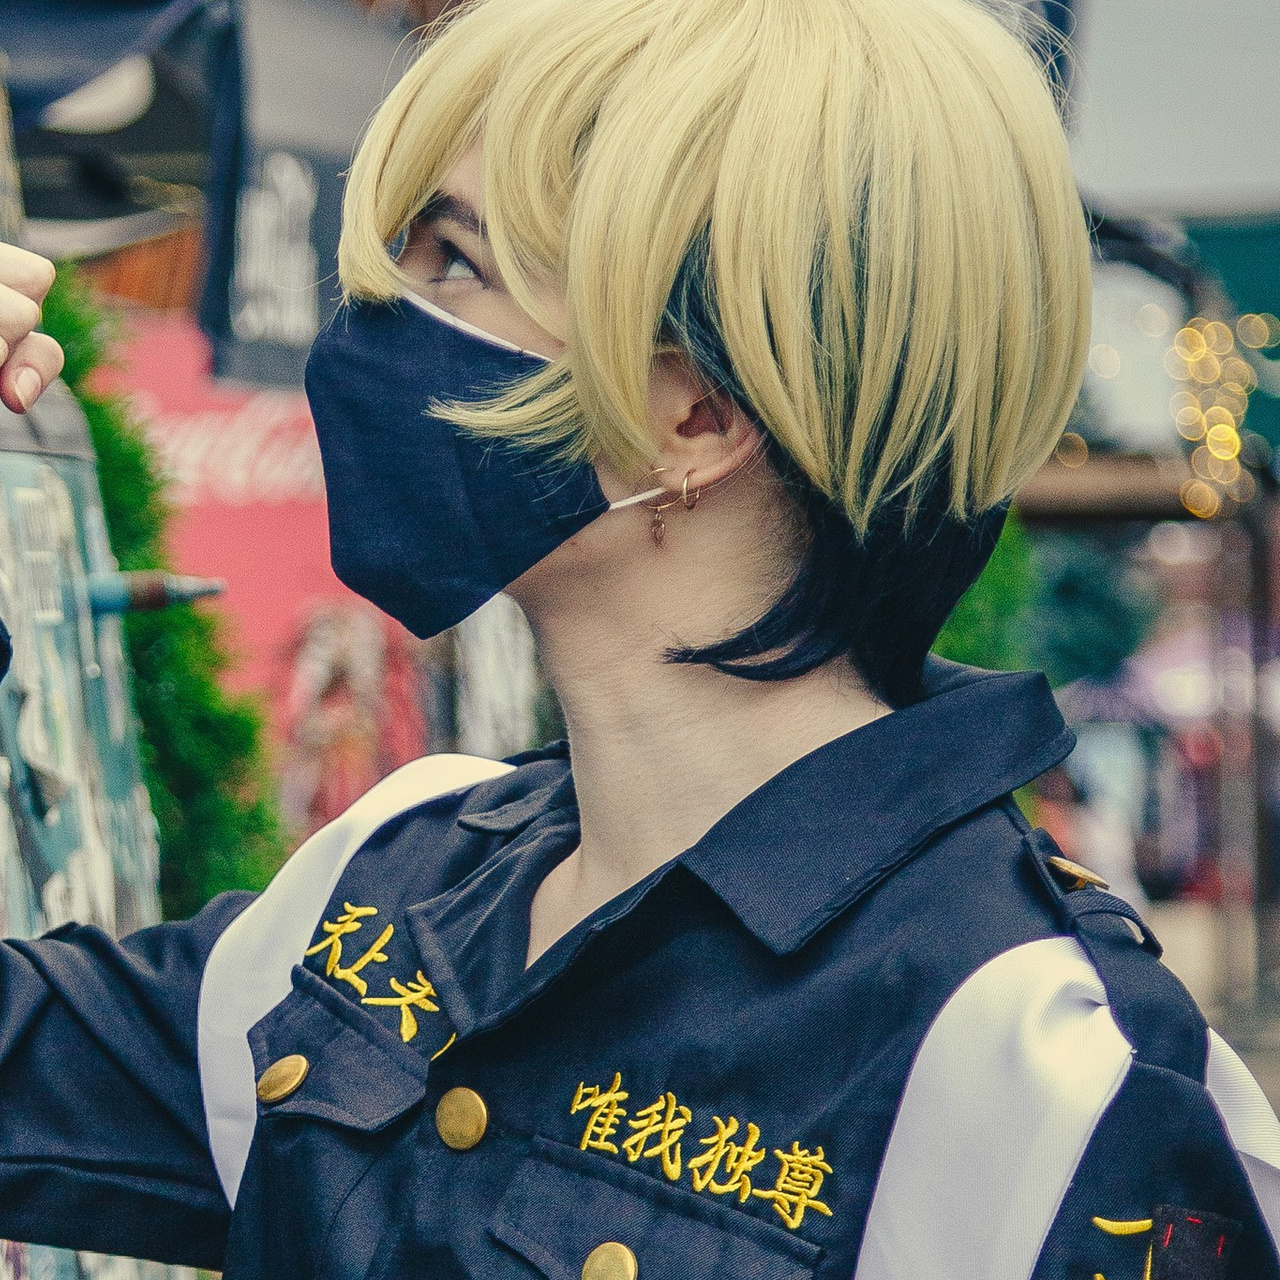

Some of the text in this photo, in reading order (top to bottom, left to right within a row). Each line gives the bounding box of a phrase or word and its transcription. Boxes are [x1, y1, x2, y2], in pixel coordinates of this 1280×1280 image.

[305, 901, 457, 1061] 天上天
[570, 1071, 834, 1229] 唯我独尊
